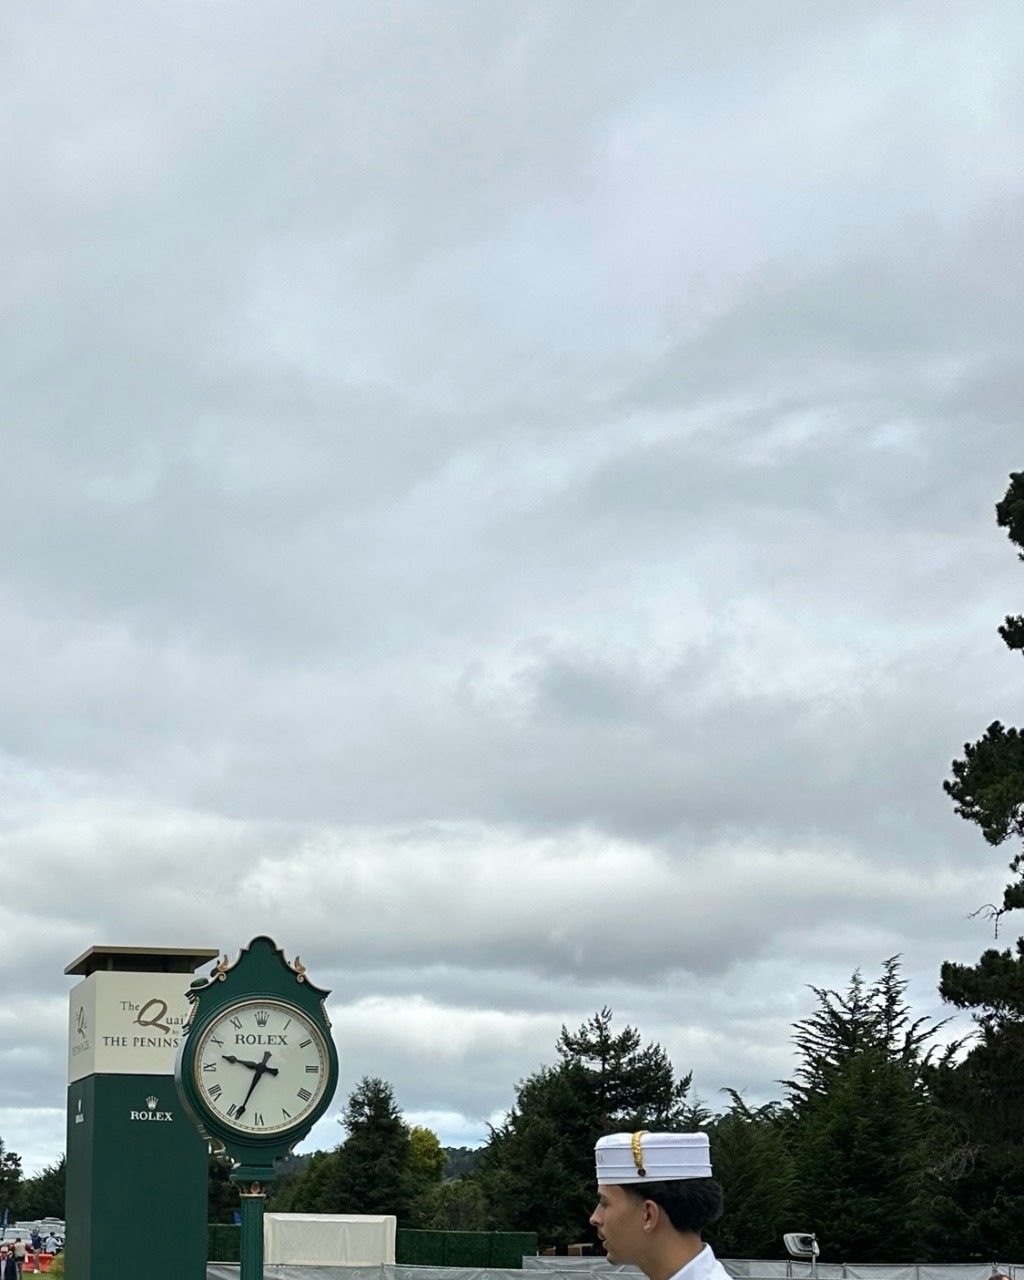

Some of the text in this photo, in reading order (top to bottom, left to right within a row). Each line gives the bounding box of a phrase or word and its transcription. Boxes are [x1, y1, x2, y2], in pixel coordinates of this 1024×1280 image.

[120, 998, 189, 1034] The Quai
[102, 1036, 180, 1048] THE PENINS
[235, 1034, 288, 1046] ROLEX
[130, 1111, 173, 1121] ROLEX
